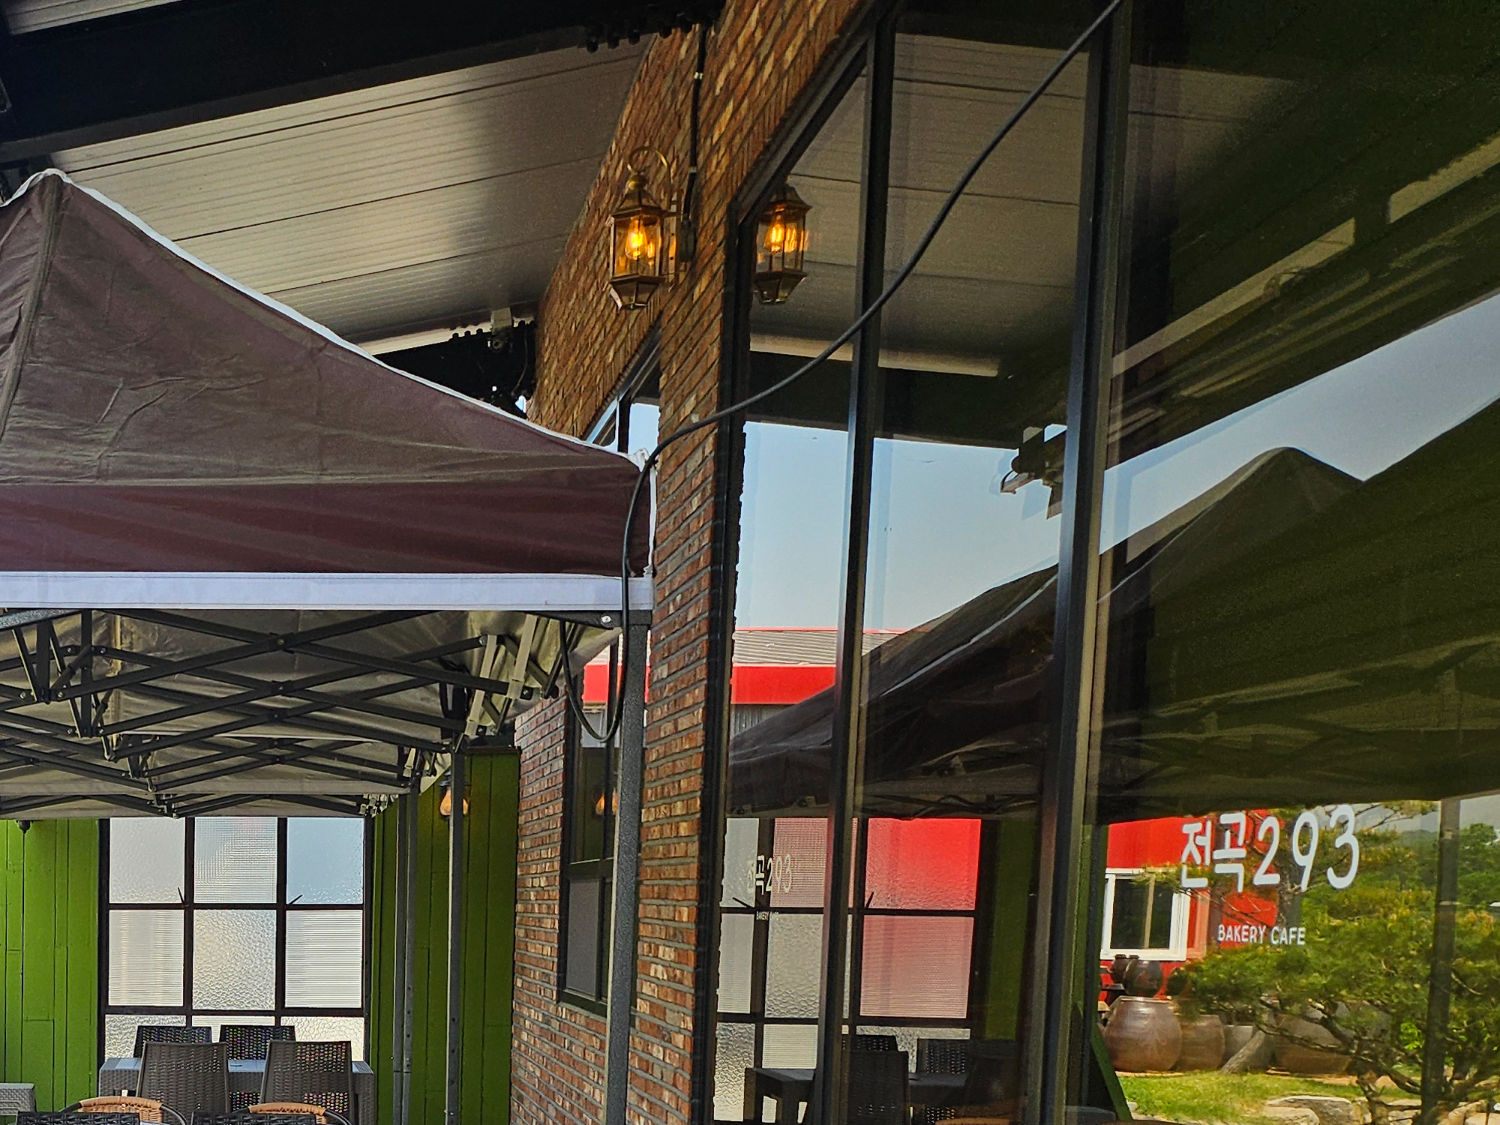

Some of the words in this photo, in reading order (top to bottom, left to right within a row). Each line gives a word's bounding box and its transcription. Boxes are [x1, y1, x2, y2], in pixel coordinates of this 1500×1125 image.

[1181, 804, 1360, 893] 전곡293
[1218, 923, 1266, 944] BAKERY
[1270, 927, 1306, 945] CAFE
